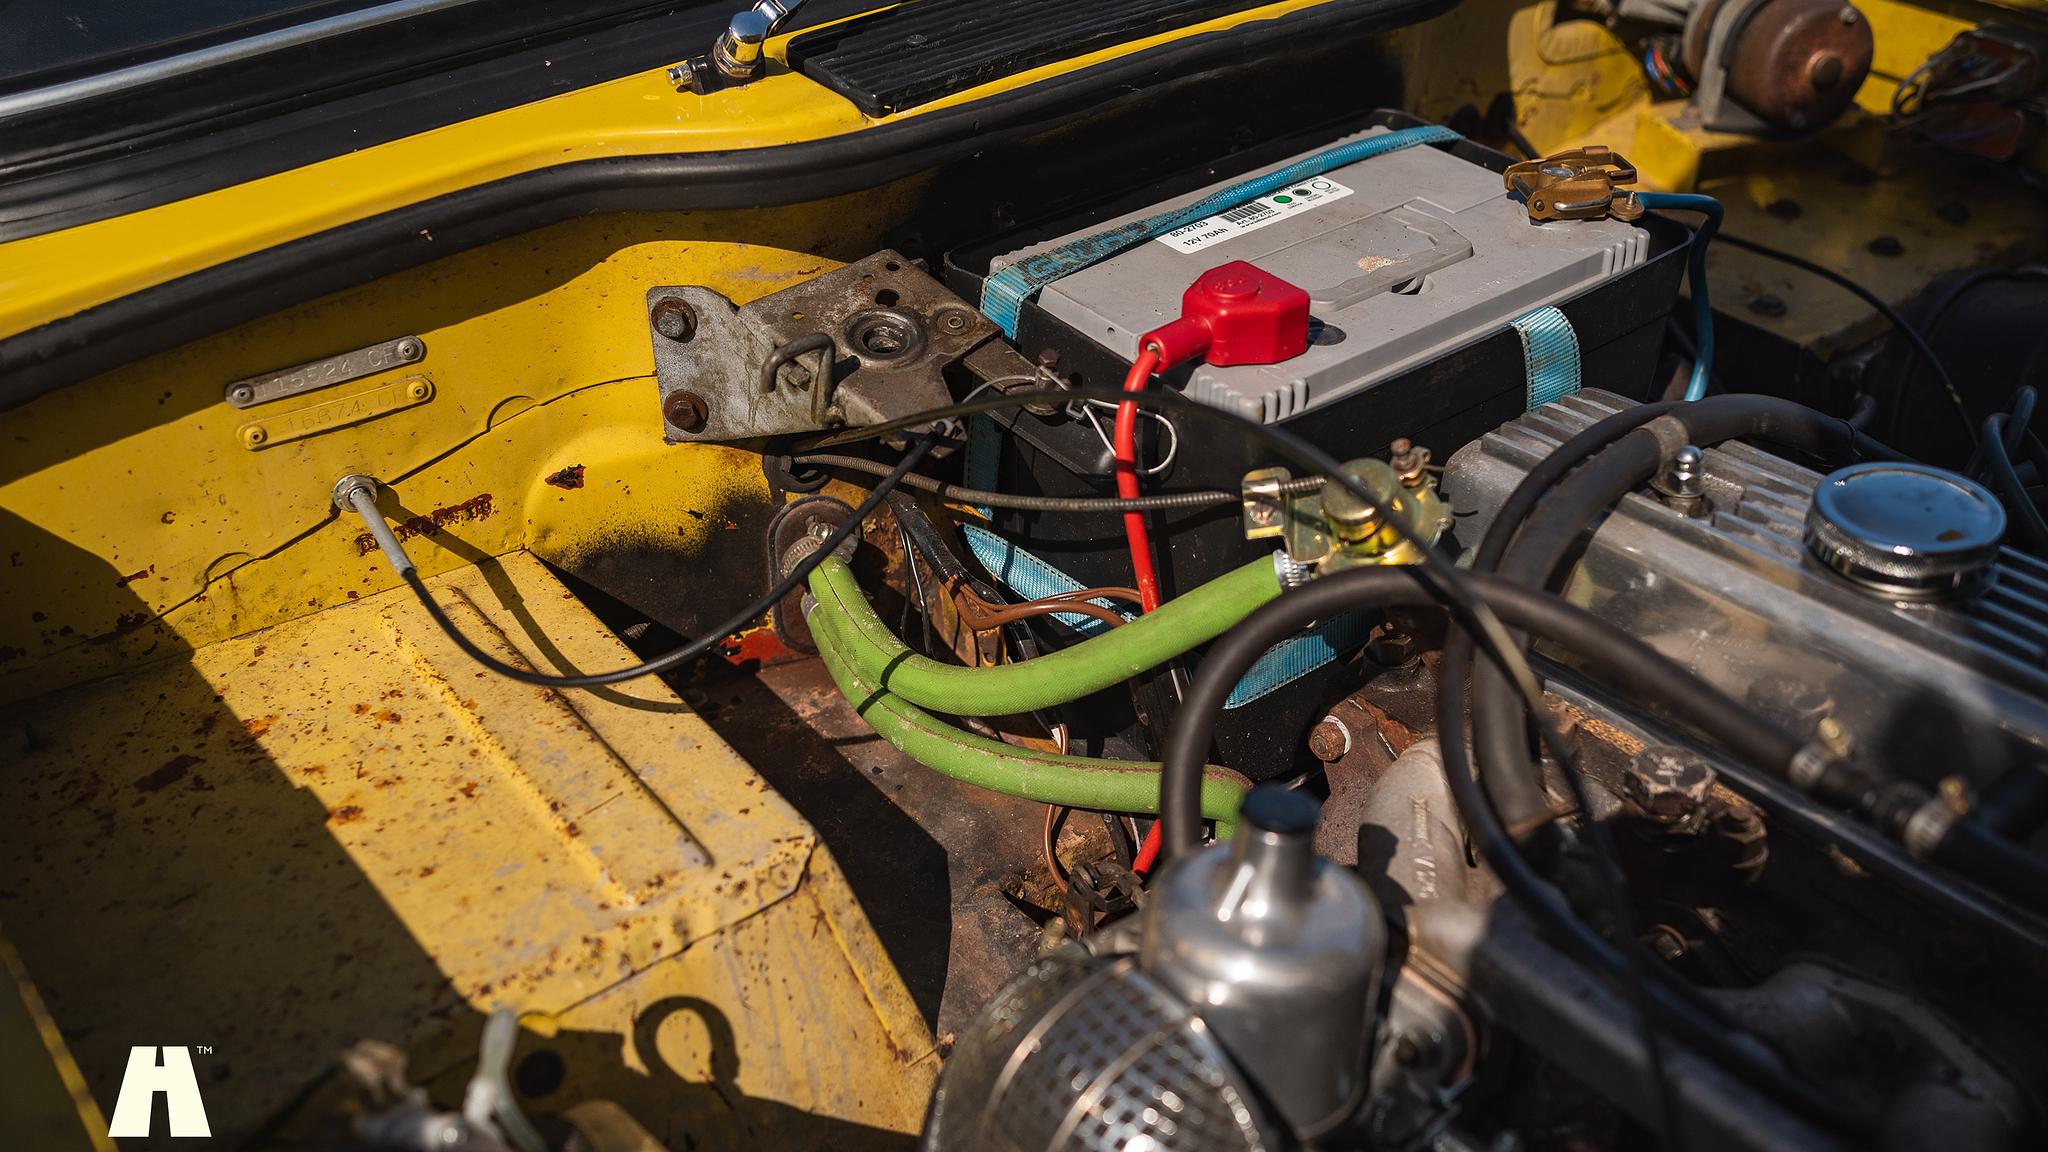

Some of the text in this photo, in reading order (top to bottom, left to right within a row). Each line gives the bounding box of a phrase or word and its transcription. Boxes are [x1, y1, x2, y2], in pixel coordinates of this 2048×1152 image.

[1169, 221, 1209, 238] 80-2703
[1183, 227, 1229, 247] 12V 70Ah
[367, 345, 397, 368] CF
